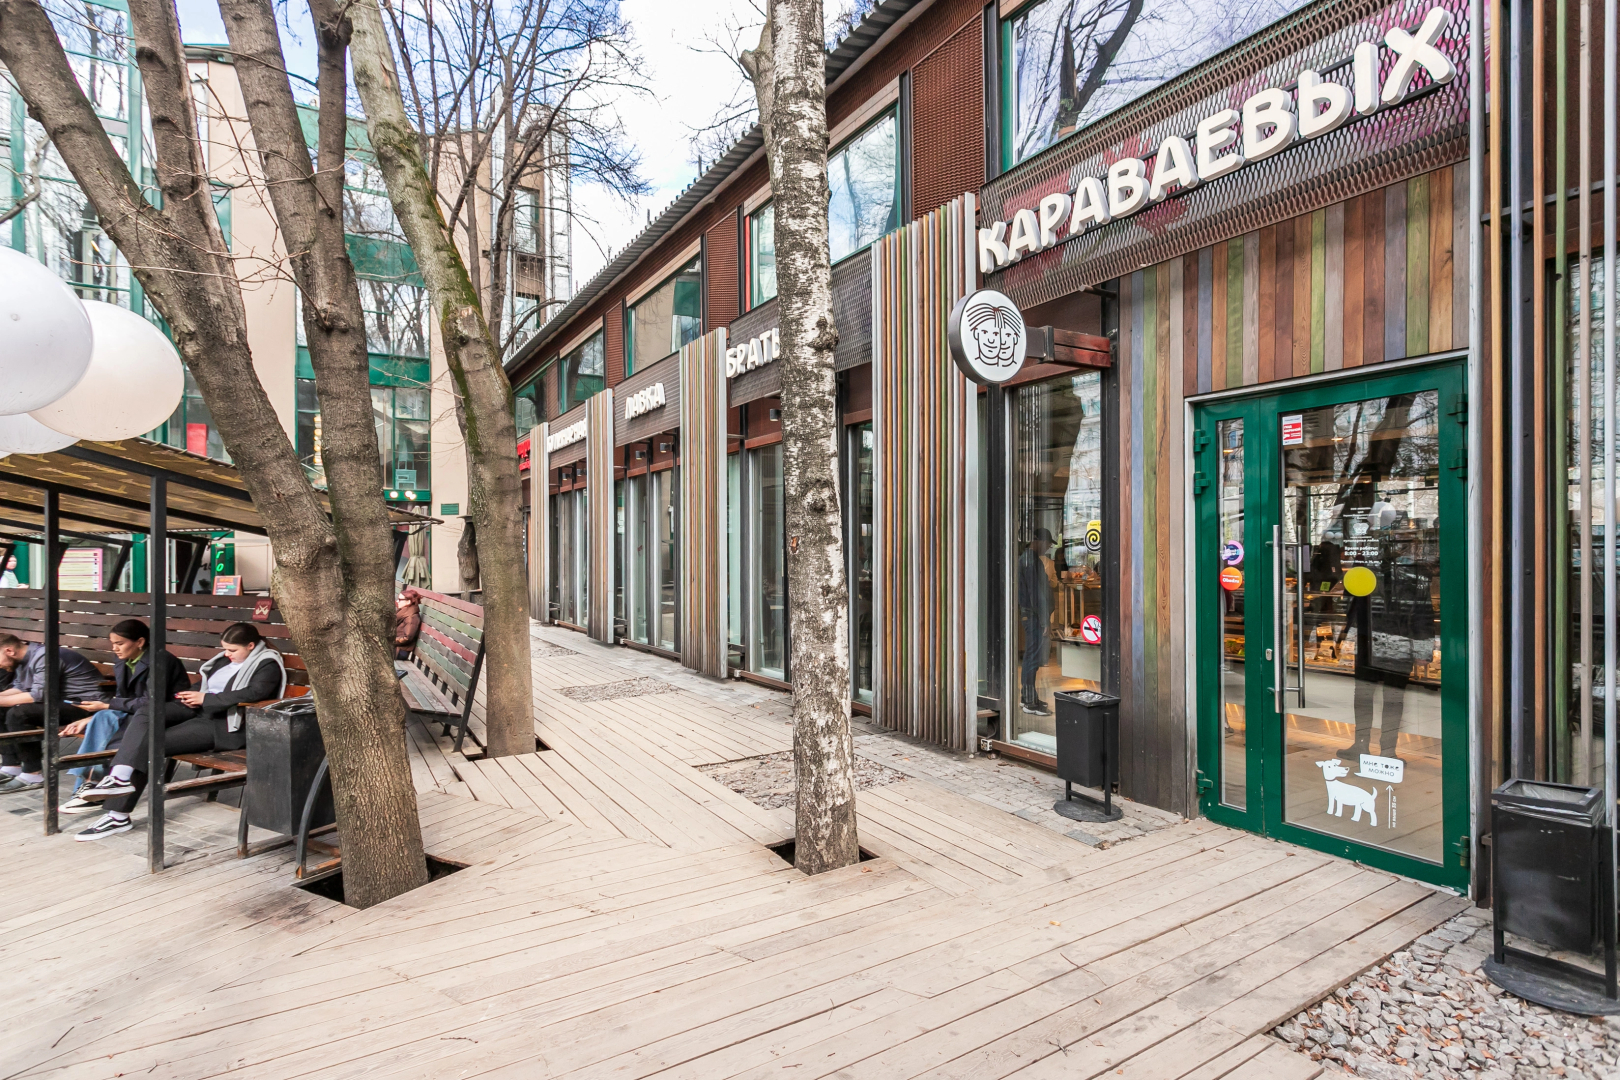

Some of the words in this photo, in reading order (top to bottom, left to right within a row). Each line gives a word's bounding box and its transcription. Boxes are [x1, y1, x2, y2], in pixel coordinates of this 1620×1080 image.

[979, 6, 1457, 274] КАРАВАЕВЫХ
[625, 382, 666, 421] ЛАВКА
[1368, 768, 1395, 777] МОЖНО
